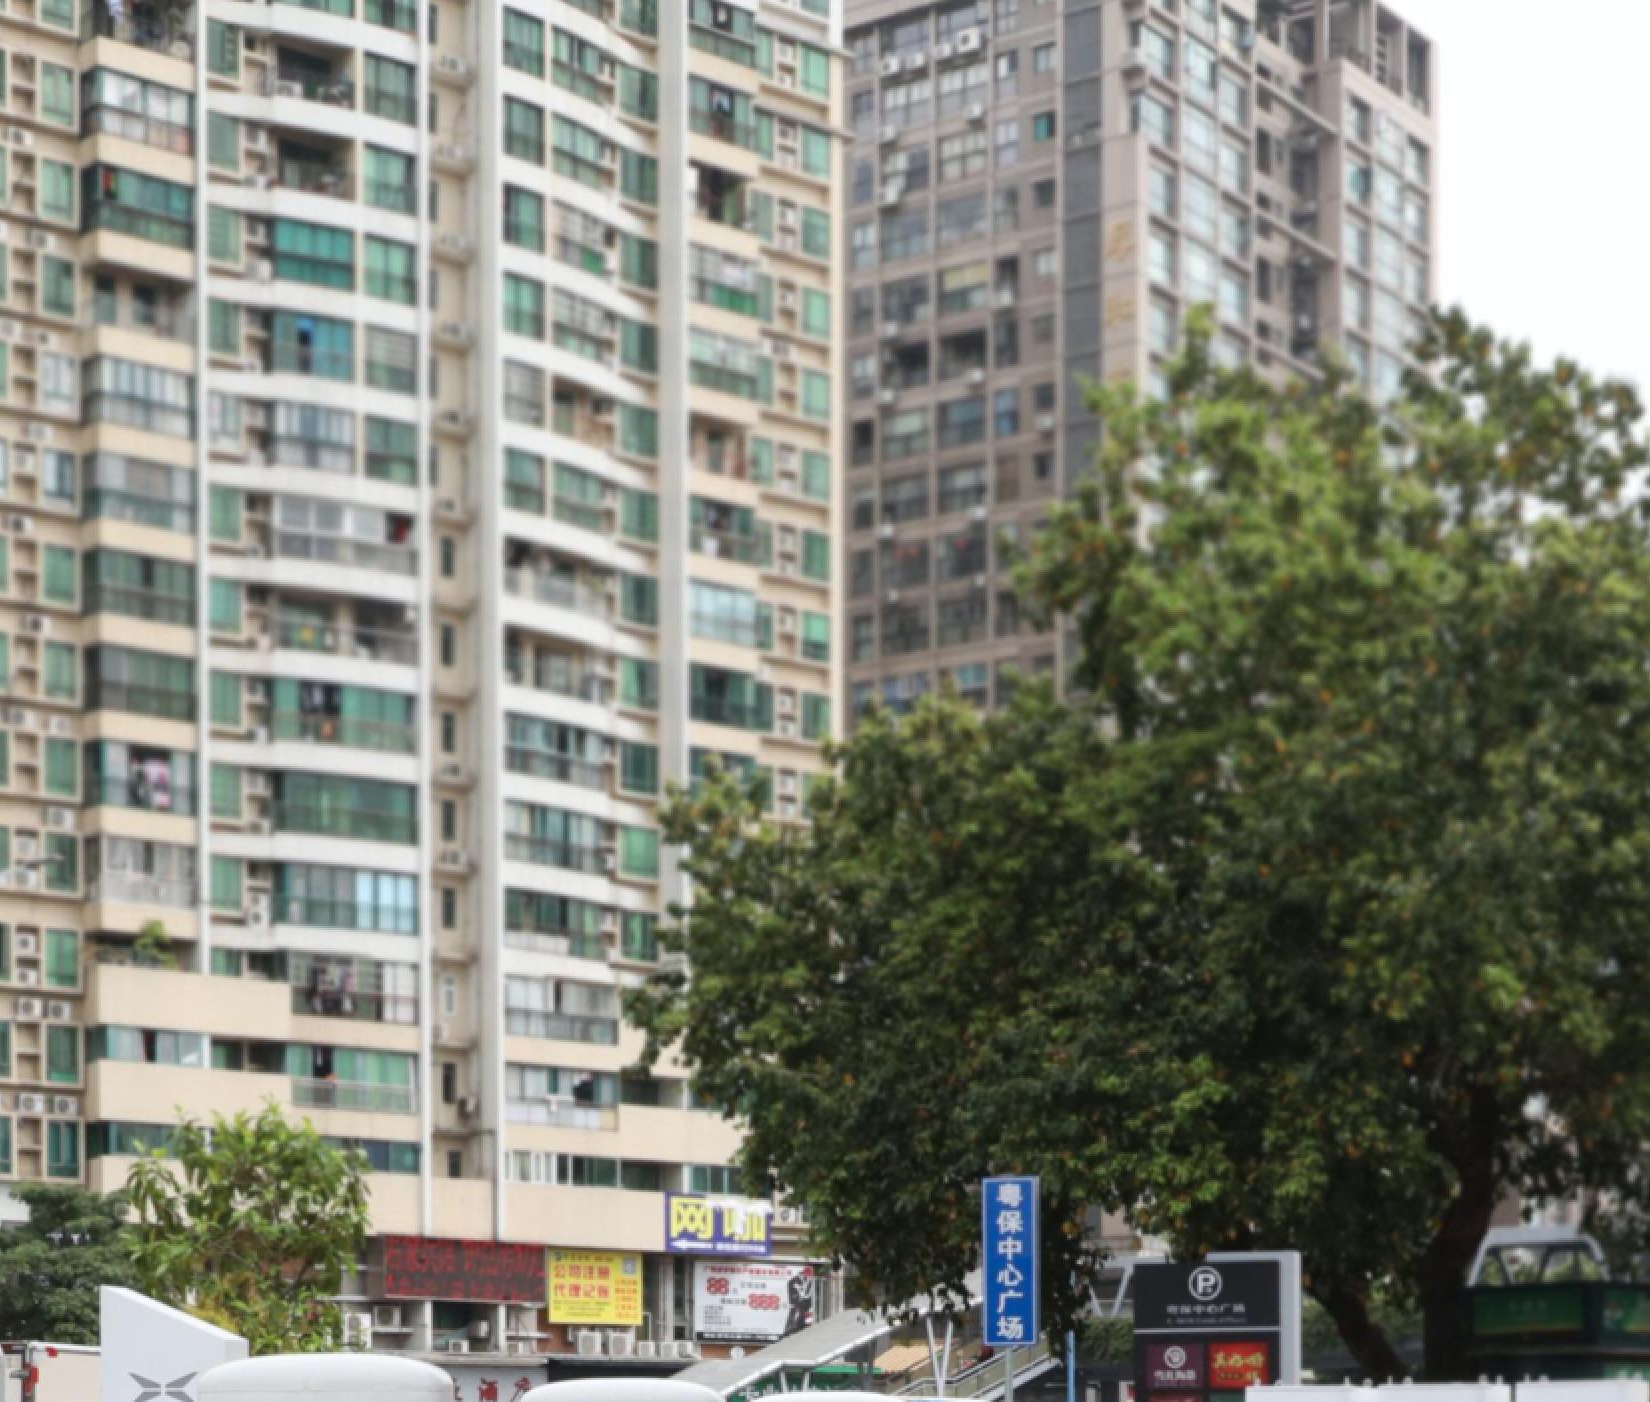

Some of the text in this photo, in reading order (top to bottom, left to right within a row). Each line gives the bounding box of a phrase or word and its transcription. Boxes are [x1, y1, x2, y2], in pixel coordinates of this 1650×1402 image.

[997, 1183, 1024, 1340] 粤保中心广场
[554, 1263, 610, 1280] 公司注册
[553, 1283, 610, 1299] 代理记账
[706, 1276, 729, 1295] 88
